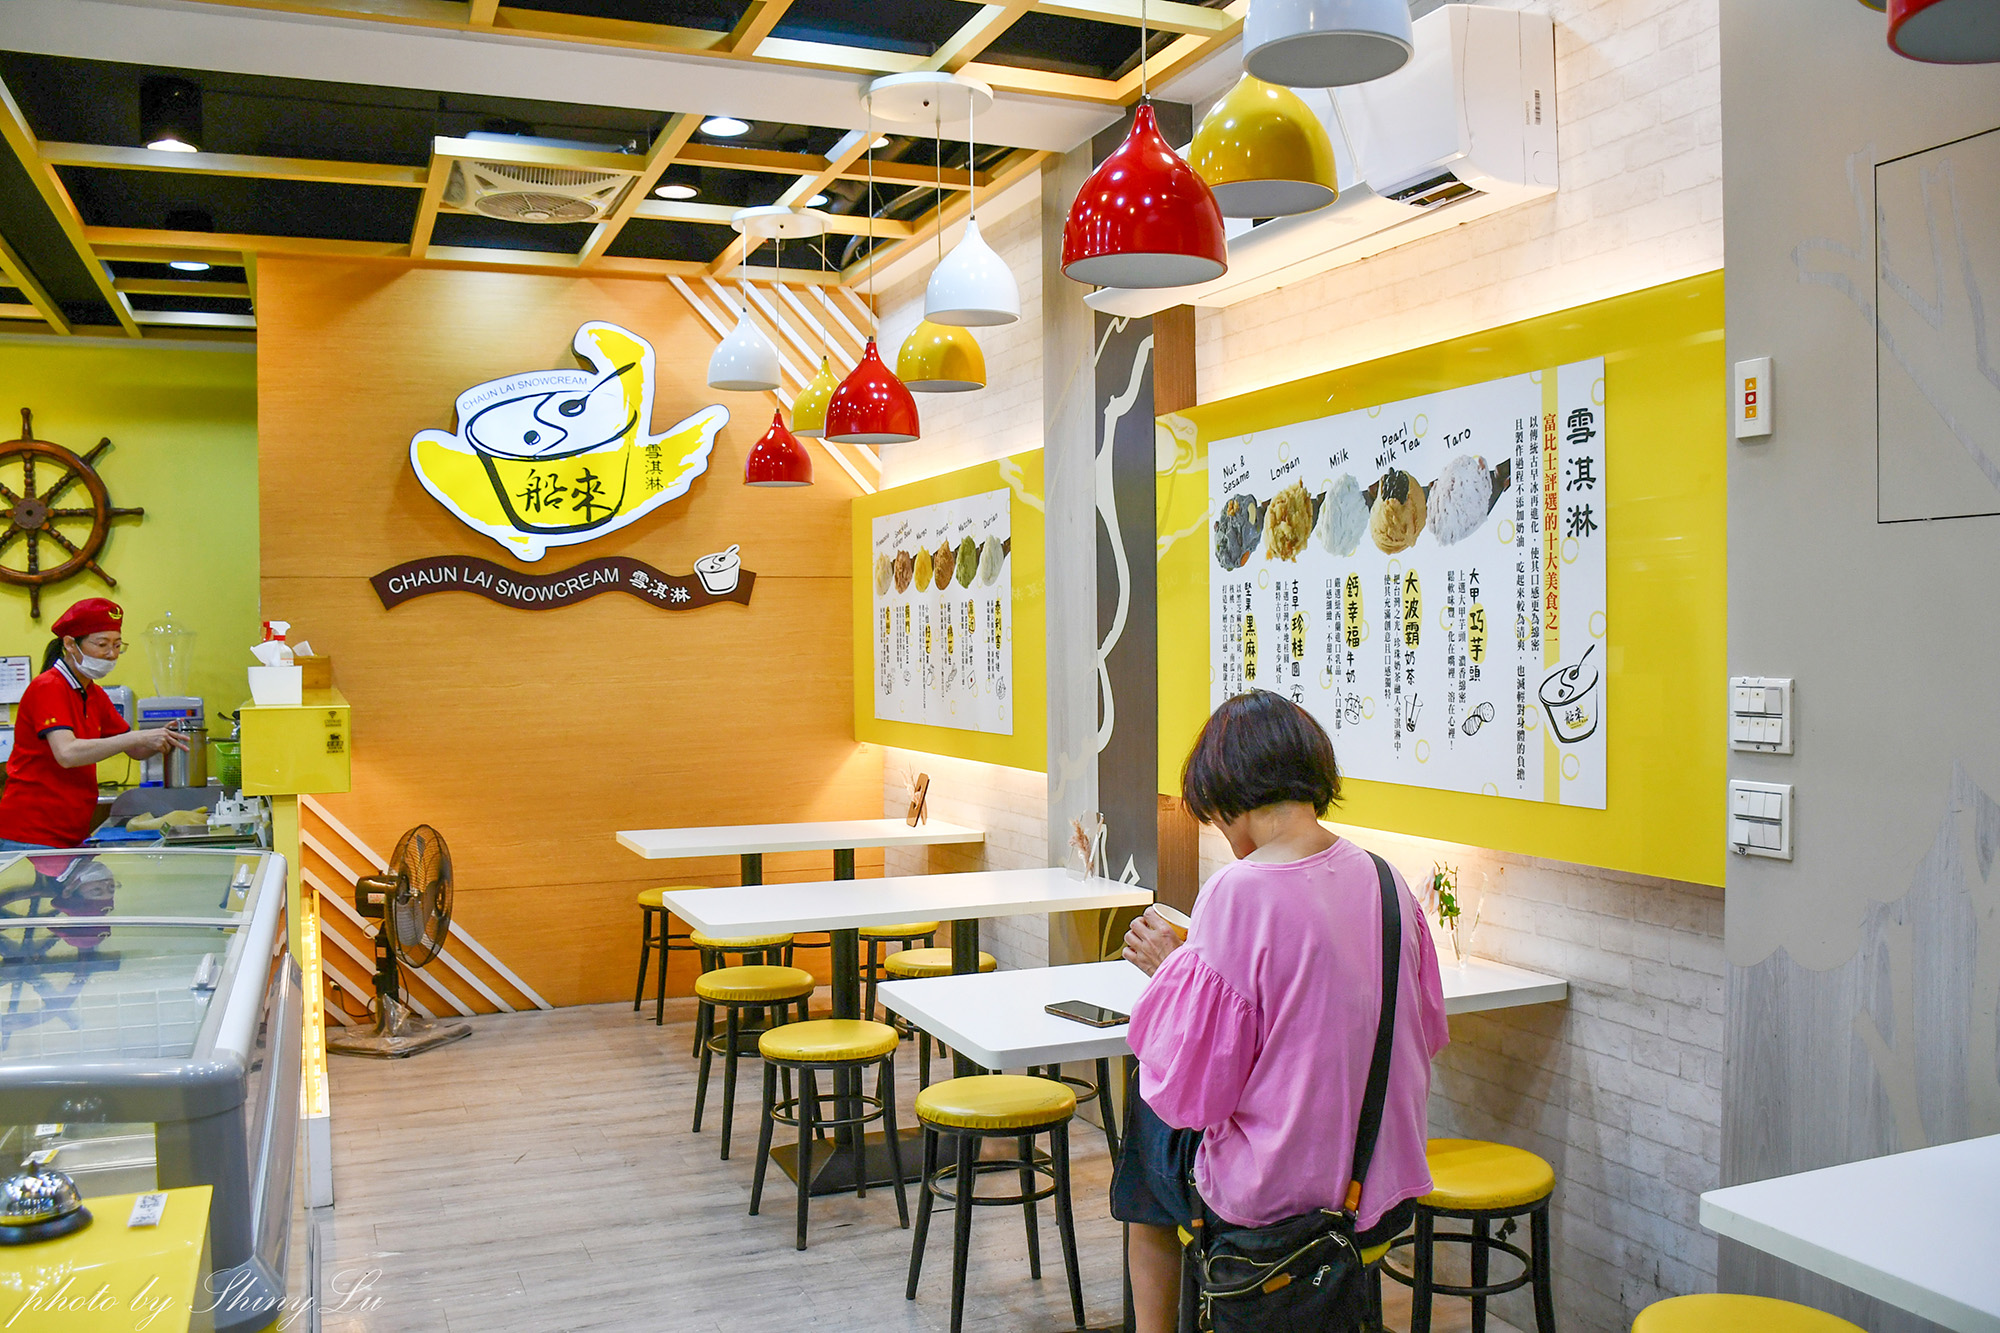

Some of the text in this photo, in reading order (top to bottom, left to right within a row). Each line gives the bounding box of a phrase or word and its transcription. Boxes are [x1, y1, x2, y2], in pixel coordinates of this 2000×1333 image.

[462, 376, 587, 410] CHAUN LAI SNOWCREAM
[1382, 422, 1408, 448] Pearl
[1443, 428, 1471, 449] Taro
[645, 443, 664, 491] 雪淇淋
[1223, 455, 1246, 479] Nut &
[1270, 456, 1300, 481] Longan
[1329, 448, 1349, 469] Milk
[1375, 438, 1421, 470] Milk Tea
[1223, 470, 1250, 494] Sesame
[1566, 407, 1598, 538] 雪淇淋
[516, 467, 613, 522] 船來
[1543, 413, 1559, 643] 富比士評選的十大美食之一
[388, 566, 692, 604] CHAUN LAI SNOWCREAM 雪淇淋
[1346, 576, 1360, 683] 鈣幸福牛奶
[1405, 572, 1420, 685] 大波霸奶茶
[1468, 568, 1484, 682] 大甲巧芋頭
